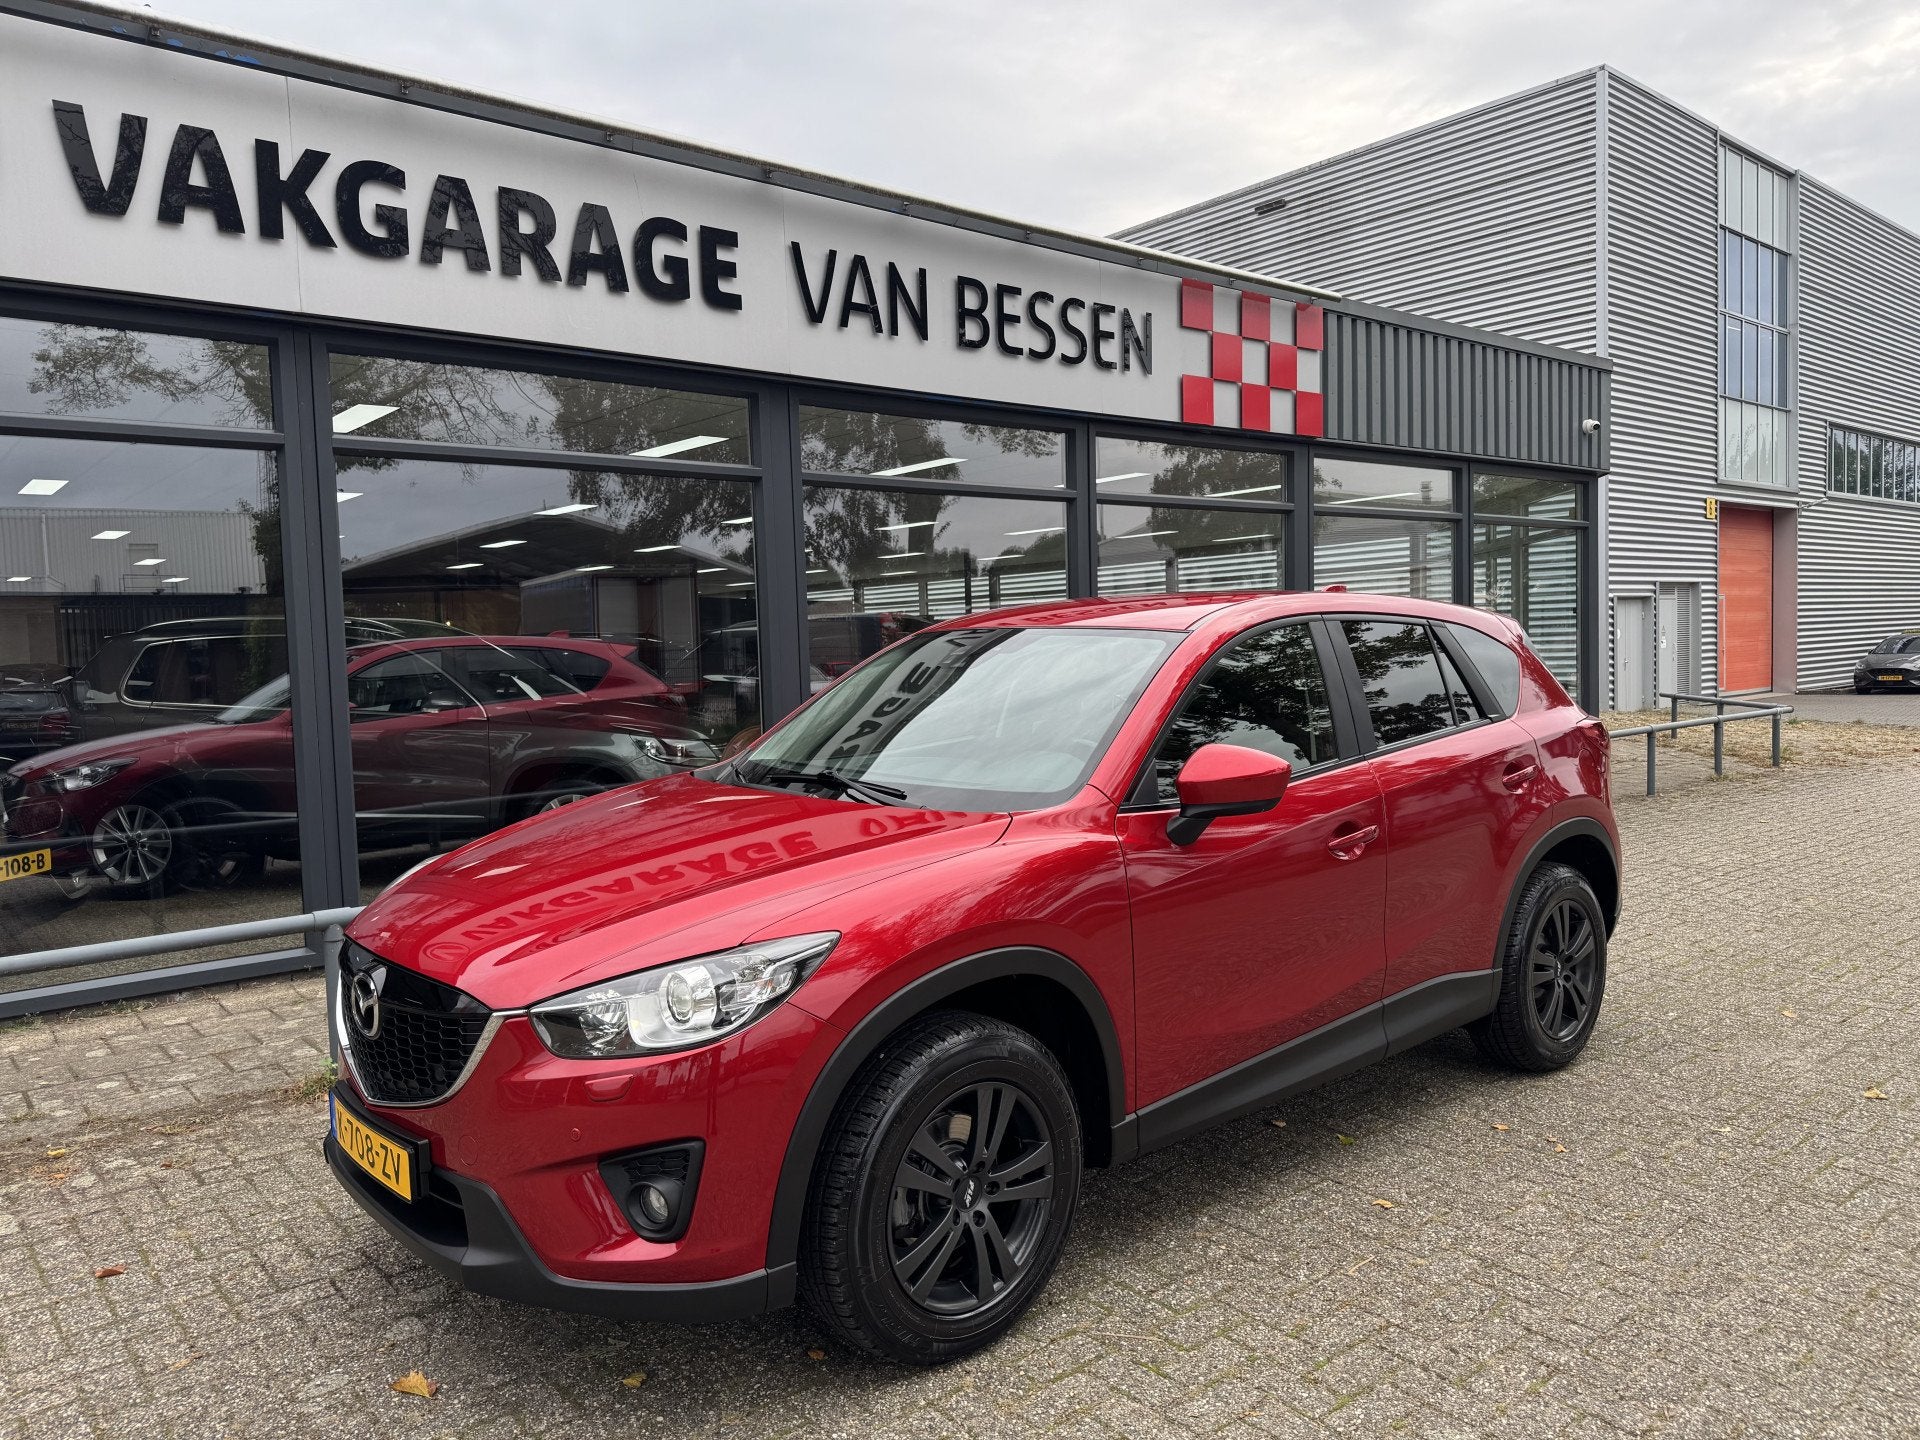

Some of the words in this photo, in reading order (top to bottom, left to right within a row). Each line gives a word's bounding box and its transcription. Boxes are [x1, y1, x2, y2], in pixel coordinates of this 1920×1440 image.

[51, 99, 743, 311] VAKGARAGE
[790, 240, 928, 342] VAN
[956, 274, 1153, 376] BESSEN
